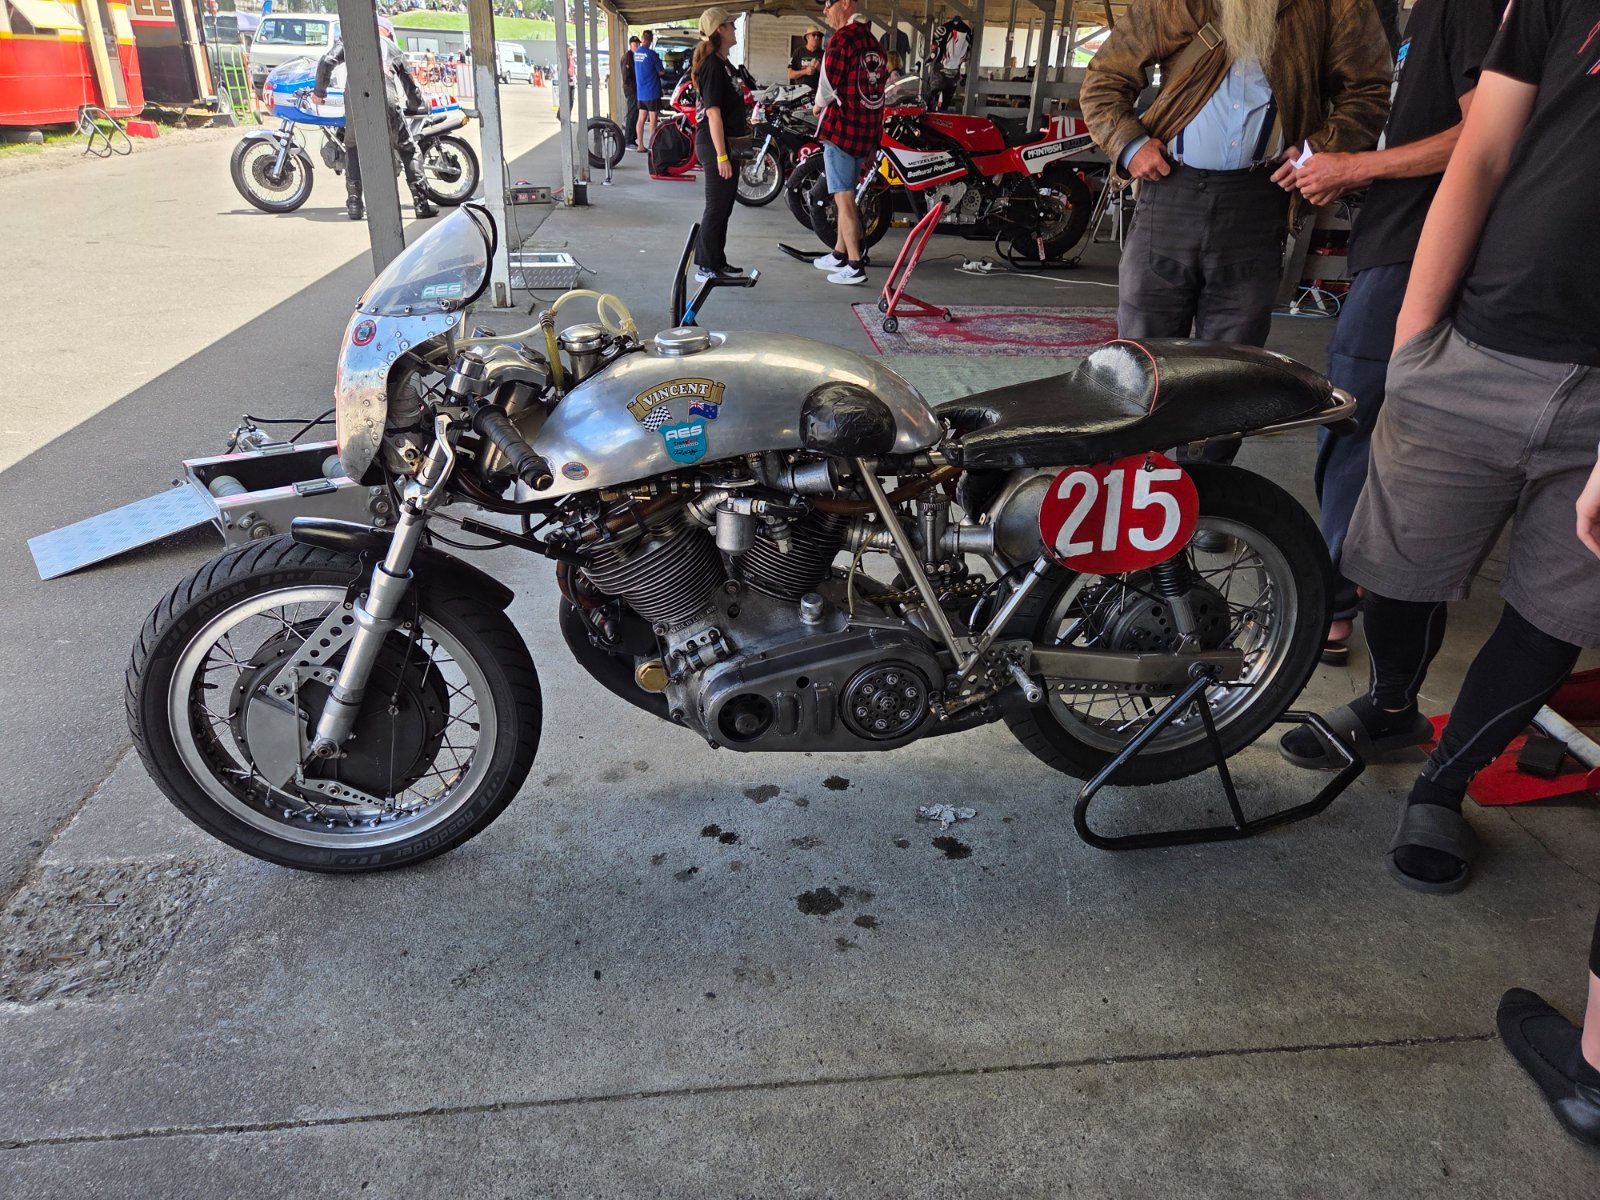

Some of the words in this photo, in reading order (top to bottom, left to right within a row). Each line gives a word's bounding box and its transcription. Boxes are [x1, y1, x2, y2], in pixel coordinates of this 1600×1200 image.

[1051, 115, 1076, 139] 70
[423, 284, 462, 297] AES
[642, 383, 709, 406] VINCENT
[665, 424, 703, 441] AES
[1055, 468, 1182, 559] 215
[196, 581, 247, 614] AVON
[393, 810, 474, 858] RoadRider
